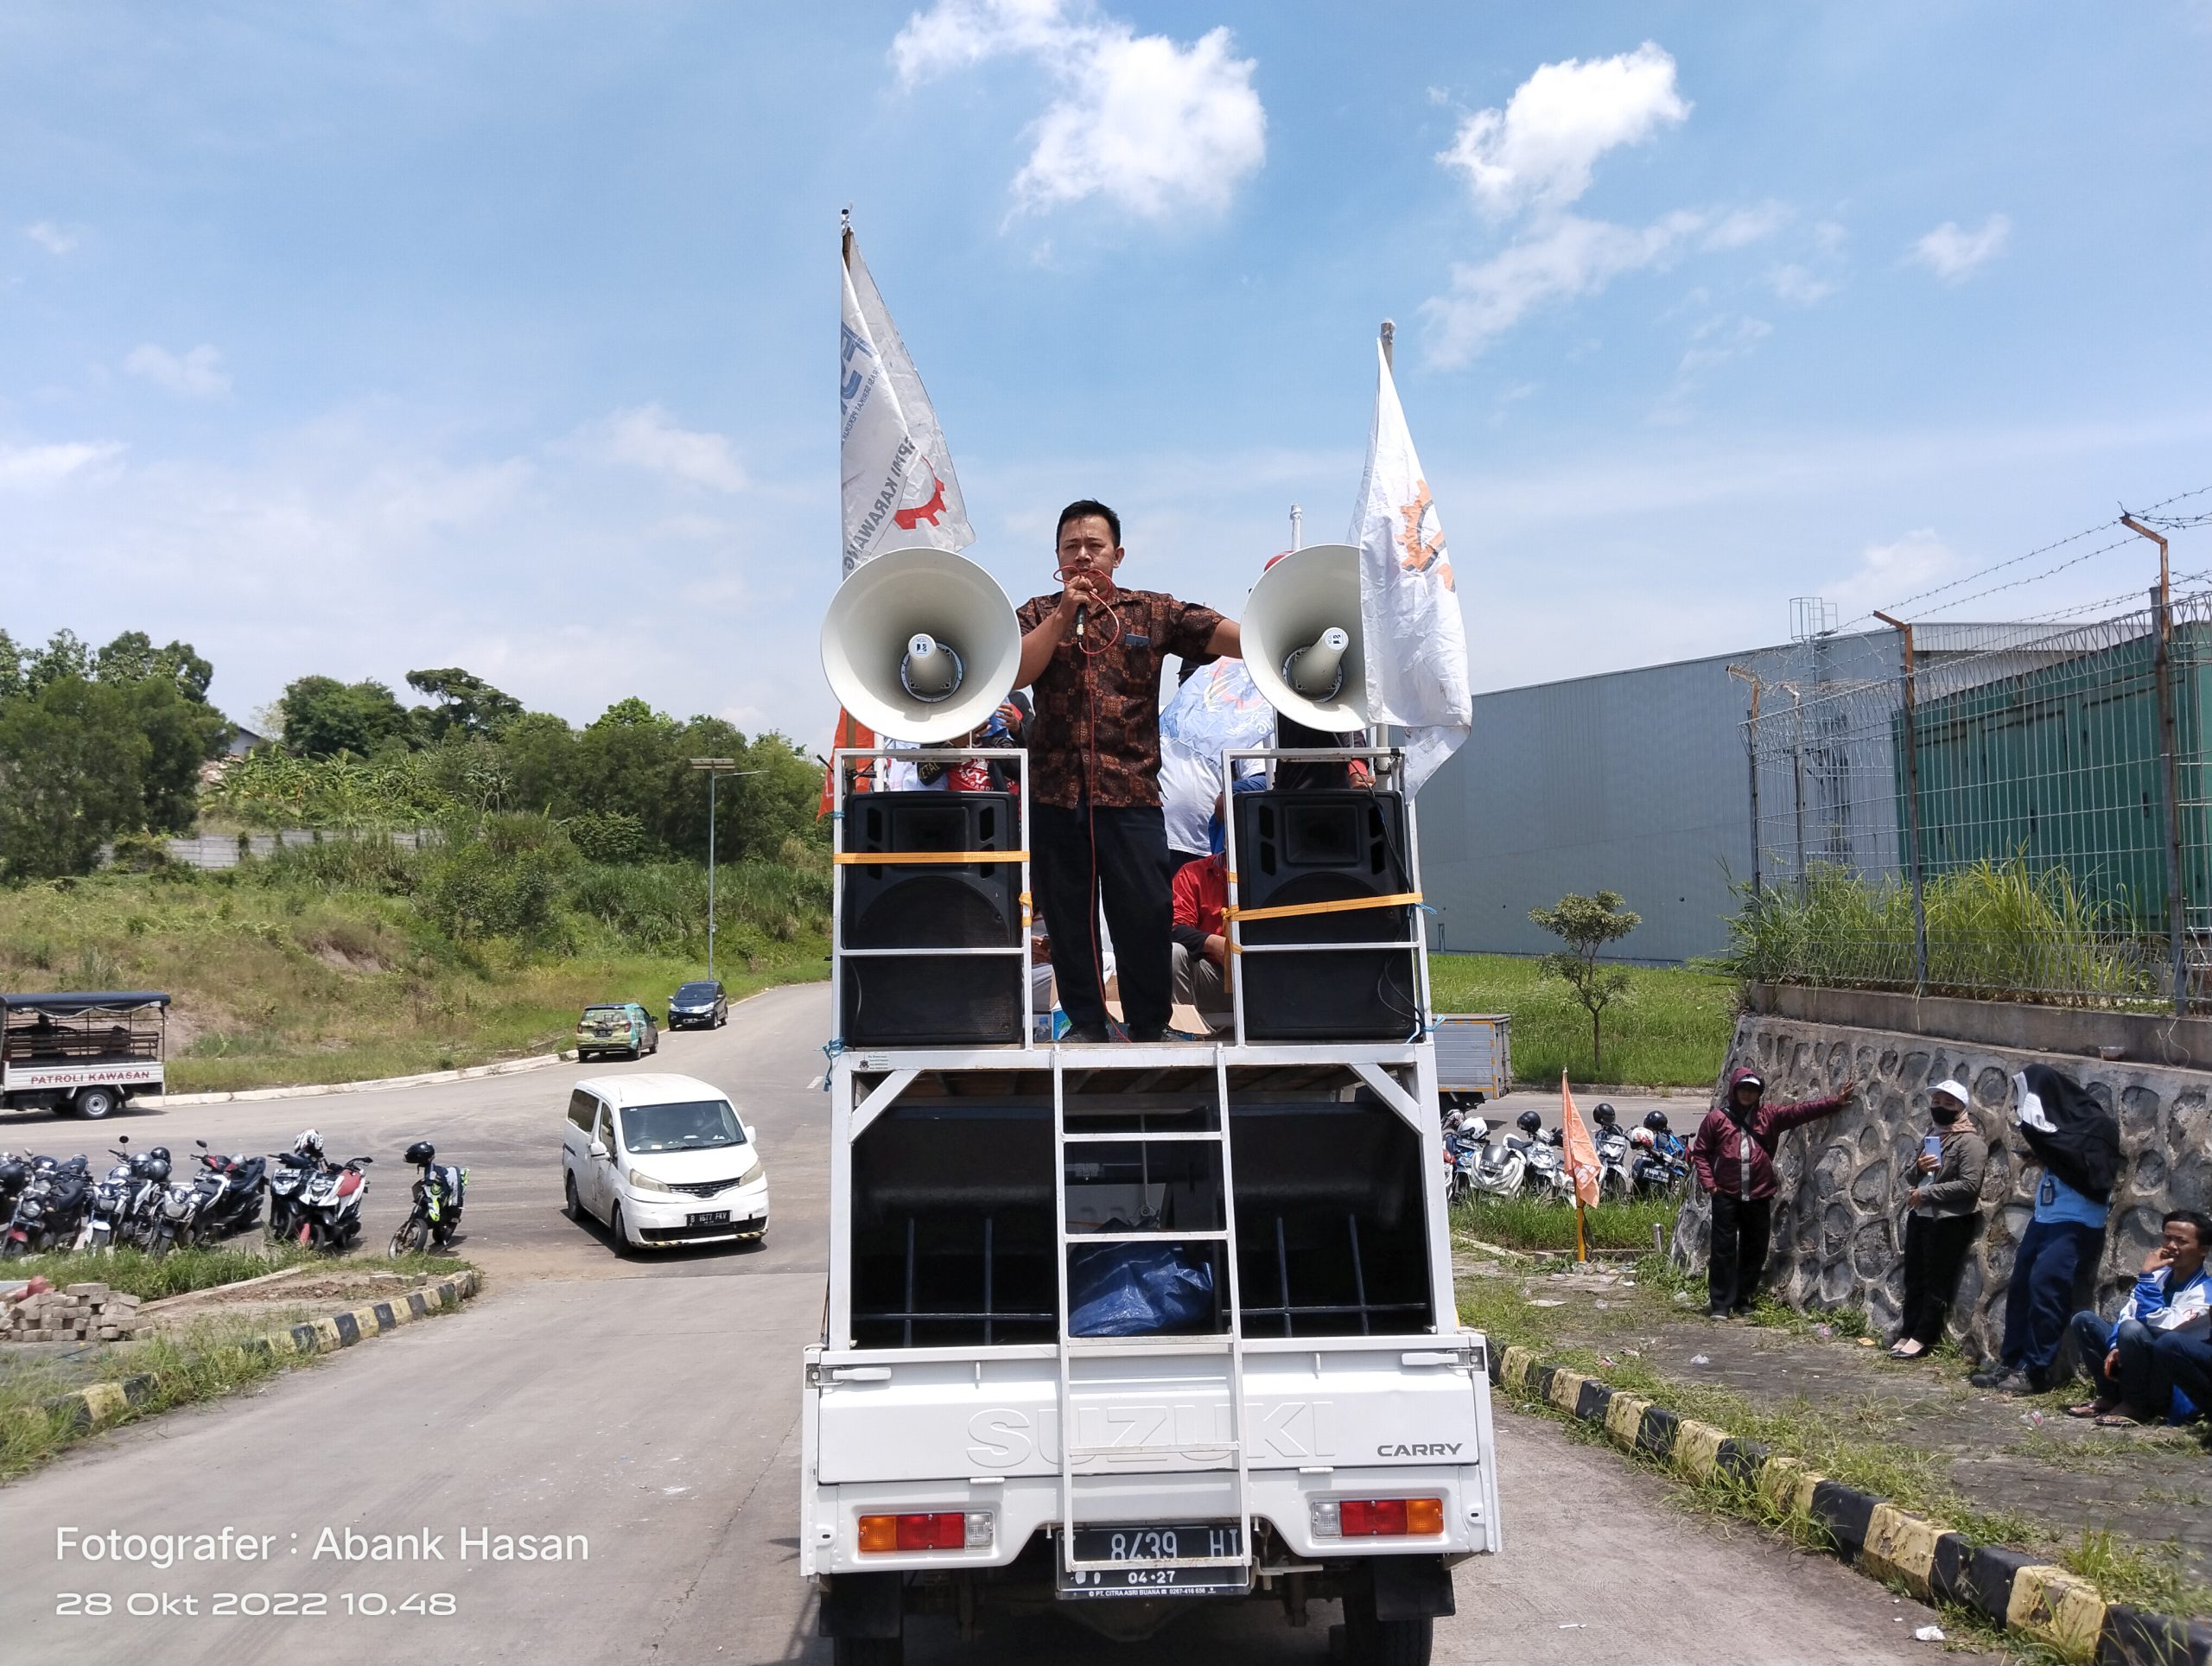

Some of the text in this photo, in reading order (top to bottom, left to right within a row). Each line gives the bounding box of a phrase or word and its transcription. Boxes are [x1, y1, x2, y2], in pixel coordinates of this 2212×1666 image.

[30, 1071, 149, 1084] PATROLI KAWASAN
[966, 1402, 1334, 1467] SUZUKI
[1377, 1443, 1463, 1457] CARRY
[1110, 1530, 1178, 1561] 8439
